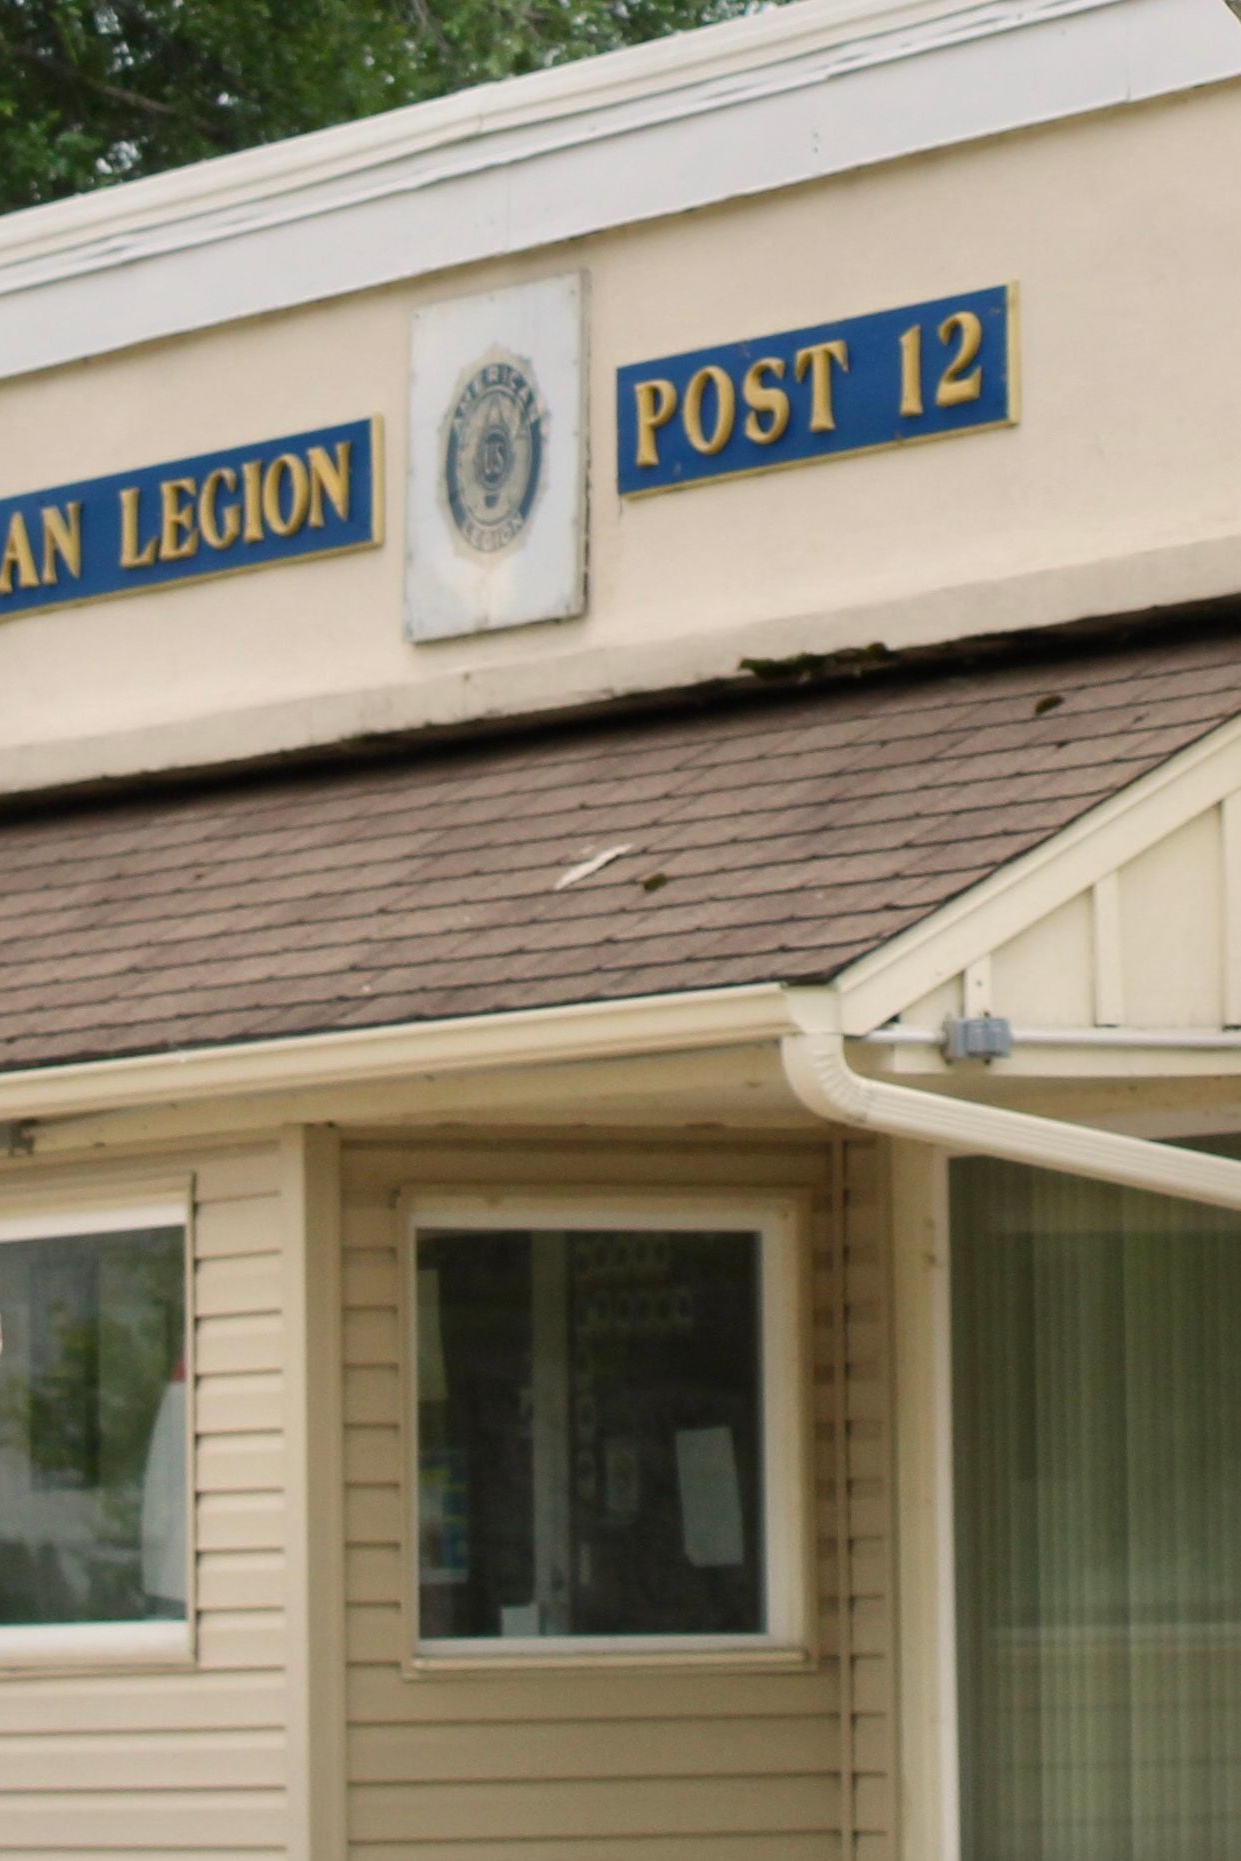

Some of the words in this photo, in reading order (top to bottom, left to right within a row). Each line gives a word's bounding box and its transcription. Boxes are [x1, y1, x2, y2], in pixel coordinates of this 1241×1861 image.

[634, 339, 851, 469] POST
[899, 310, 984, 418] 12
[119, 441, 352, 569] LEGION
